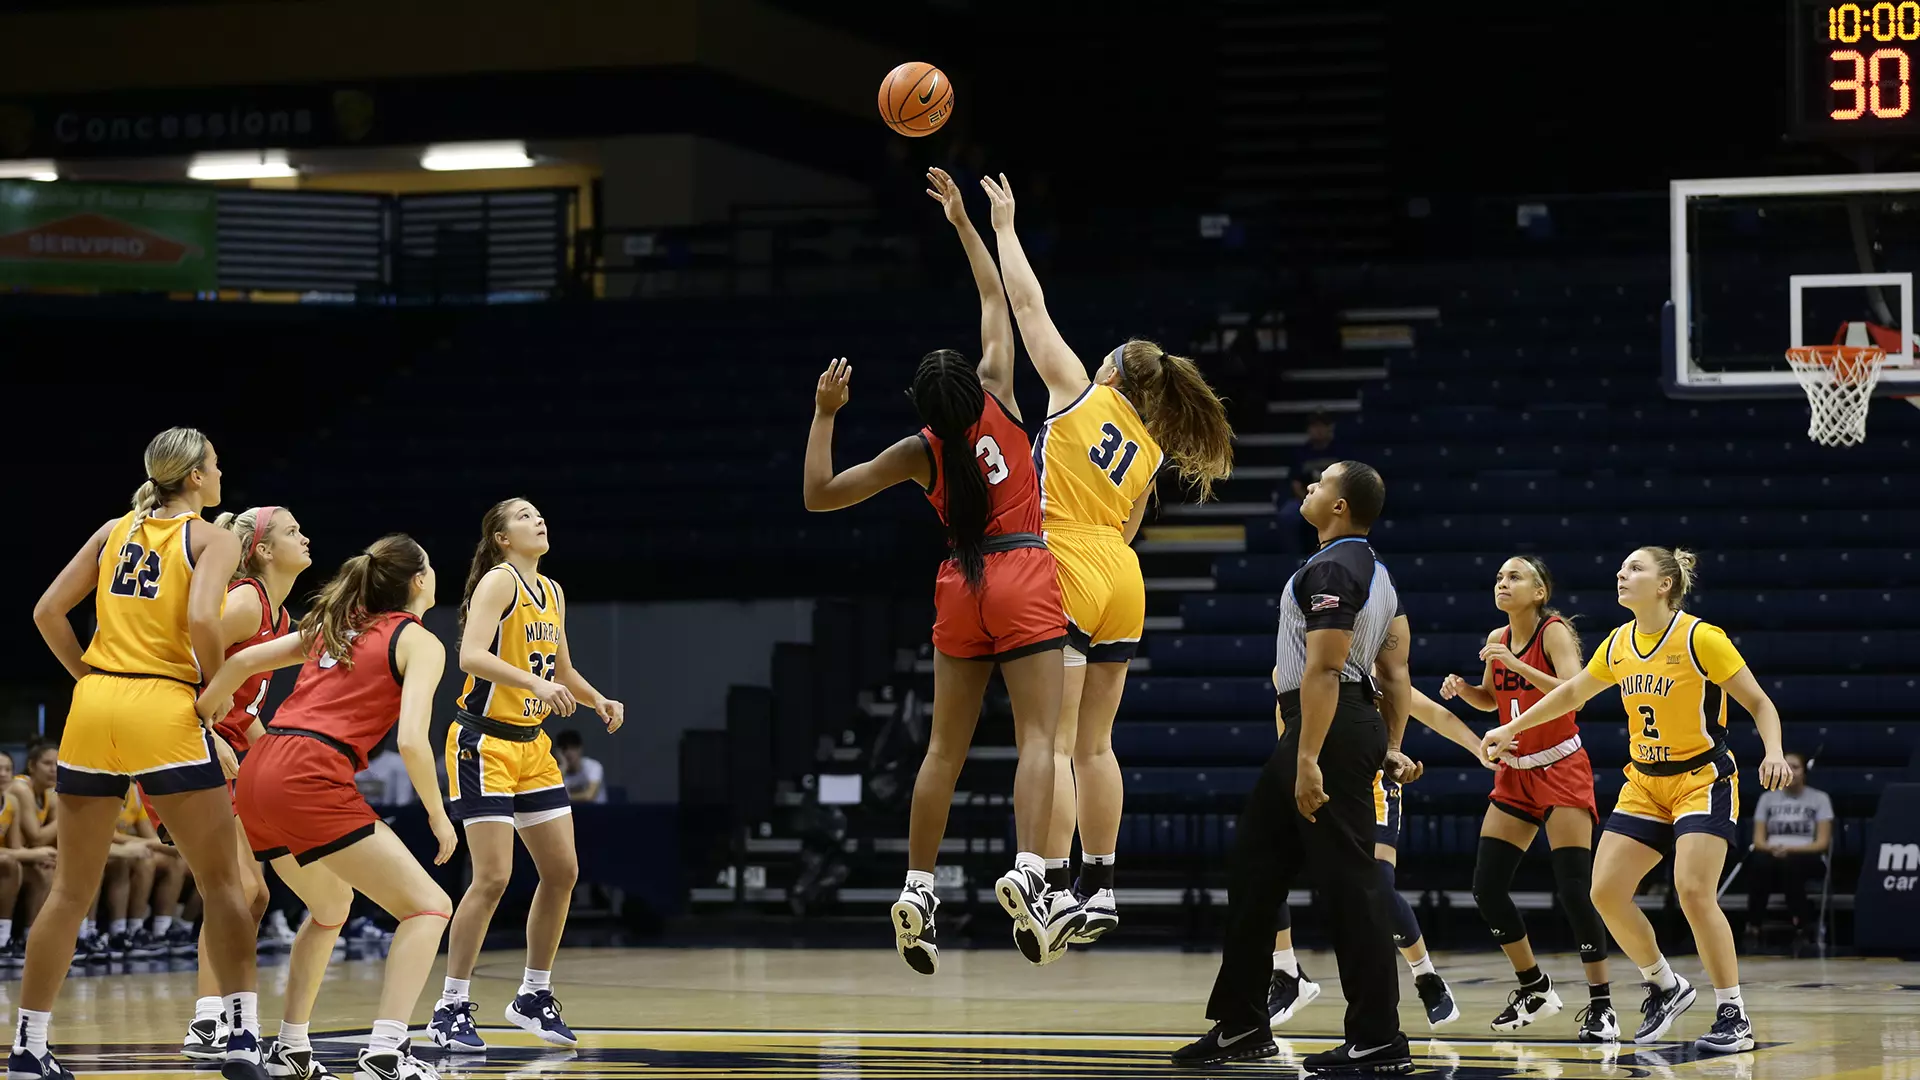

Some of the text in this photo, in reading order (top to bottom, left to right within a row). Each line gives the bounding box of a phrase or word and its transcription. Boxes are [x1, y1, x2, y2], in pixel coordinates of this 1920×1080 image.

[1829, 1, 1920, 43] 10:00
[1830, 48, 1911, 120] 30
[54, 108, 313, 143] Concessions
[28, 233, 146, 257] SERVPRO
[1089, 422, 1139, 487] 31
[109, 542, 162, 600] 22
[525, 621, 560, 644] MURRA
[1637, 704, 1661, 740] 2
